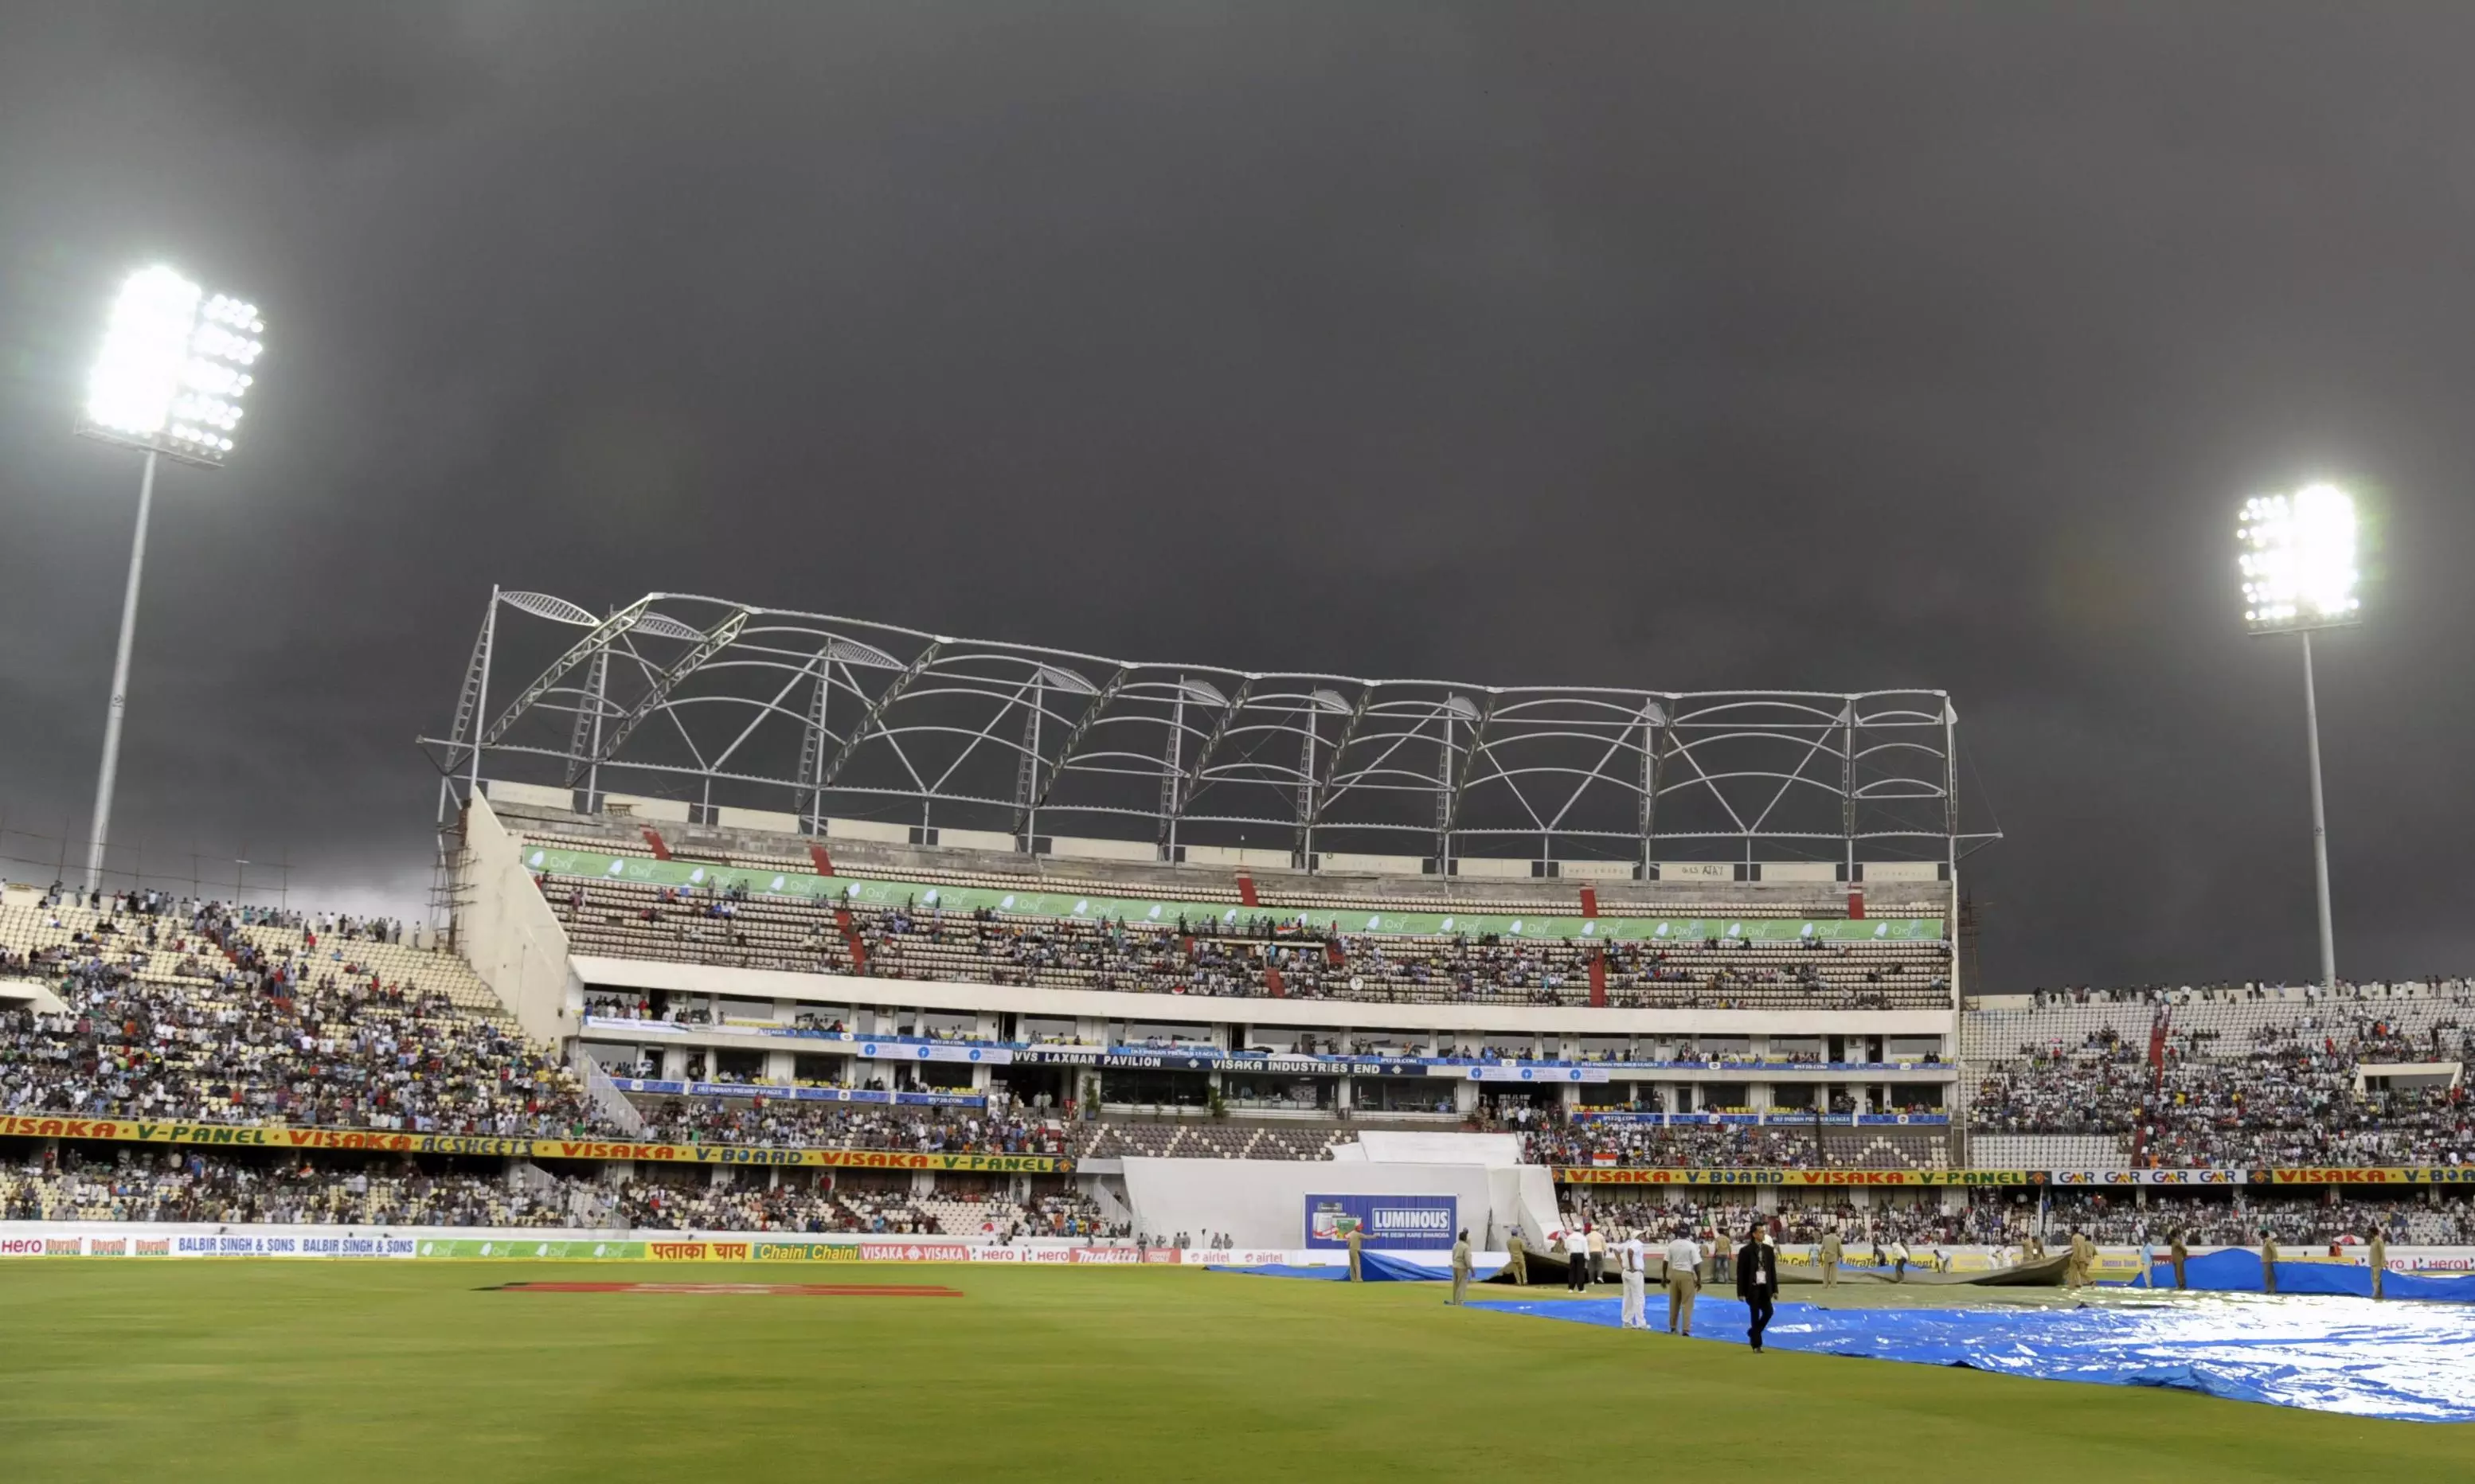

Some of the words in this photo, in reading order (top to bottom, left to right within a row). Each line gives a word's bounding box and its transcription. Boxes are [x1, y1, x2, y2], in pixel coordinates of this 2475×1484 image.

[1015, 1051, 1038, 1062] VVS
[1045, 1052, 1097, 1064] LAXMAN
[1104, 1056, 1161, 1068] PAVILION
[1212, 1059, 1263, 1071] VISAKA
[1268, 1060, 1347, 1073] INDUSTRIES
[1354, 1064, 1380, 1074] END
[137, 1124, 266, 1144] V-PANEL
[287, 1130, 412, 1150] VISAKA
[561, 1142, 674, 1159] VISAKA
[695, 1147, 803, 1164] V-BOARD
[821, 1152, 929, 1168] VISAKA
[943, 1155, 1049, 1171] V-PANEL
[1569, 1170, 1671, 1183] VISAKA
[1685, 1171, 1785, 1183] V-BOARD
[1801, 1172, 1904, 1184] VISAKA
[1920, 1172, 2023, 1184] V-PANEL
[2277, 1170, 2386, 1182] VISAKA
[1375, 1211, 1448, 1228] LUMINOUS
[2, 1240, 42, 1252] Hero
[178, 1237, 217, 1251] BALBIR
[220, 1237, 252, 1252] SINGH
[256, 1239, 264, 1251] &
[267, 1238, 295, 1252] SONS
[303, 1239, 338, 1252] BALBIR
[342, 1239, 373, 1252] SINGH
[376, 1240, 384, 1252] &
[387, 1240, 413, 1252] SONS
[651, 1244, 707, 1259] पताका
[713, 1244, 747, 1259] चाय
[760, 1244, 807, 1259] Chaini
[812, 1244, 858, 1260] Chaini
[862, 1246, 904, 1260] VISAKA
[923, 1247, 964, 1260] VISAKA
[982, 1250, 1014, 1260] Hero
[1037, 1251, 1069, 1261] Hero
[1202, 1252, 1230, 1262] airtel
[1257, 1252, 1284, 1263] airtel
